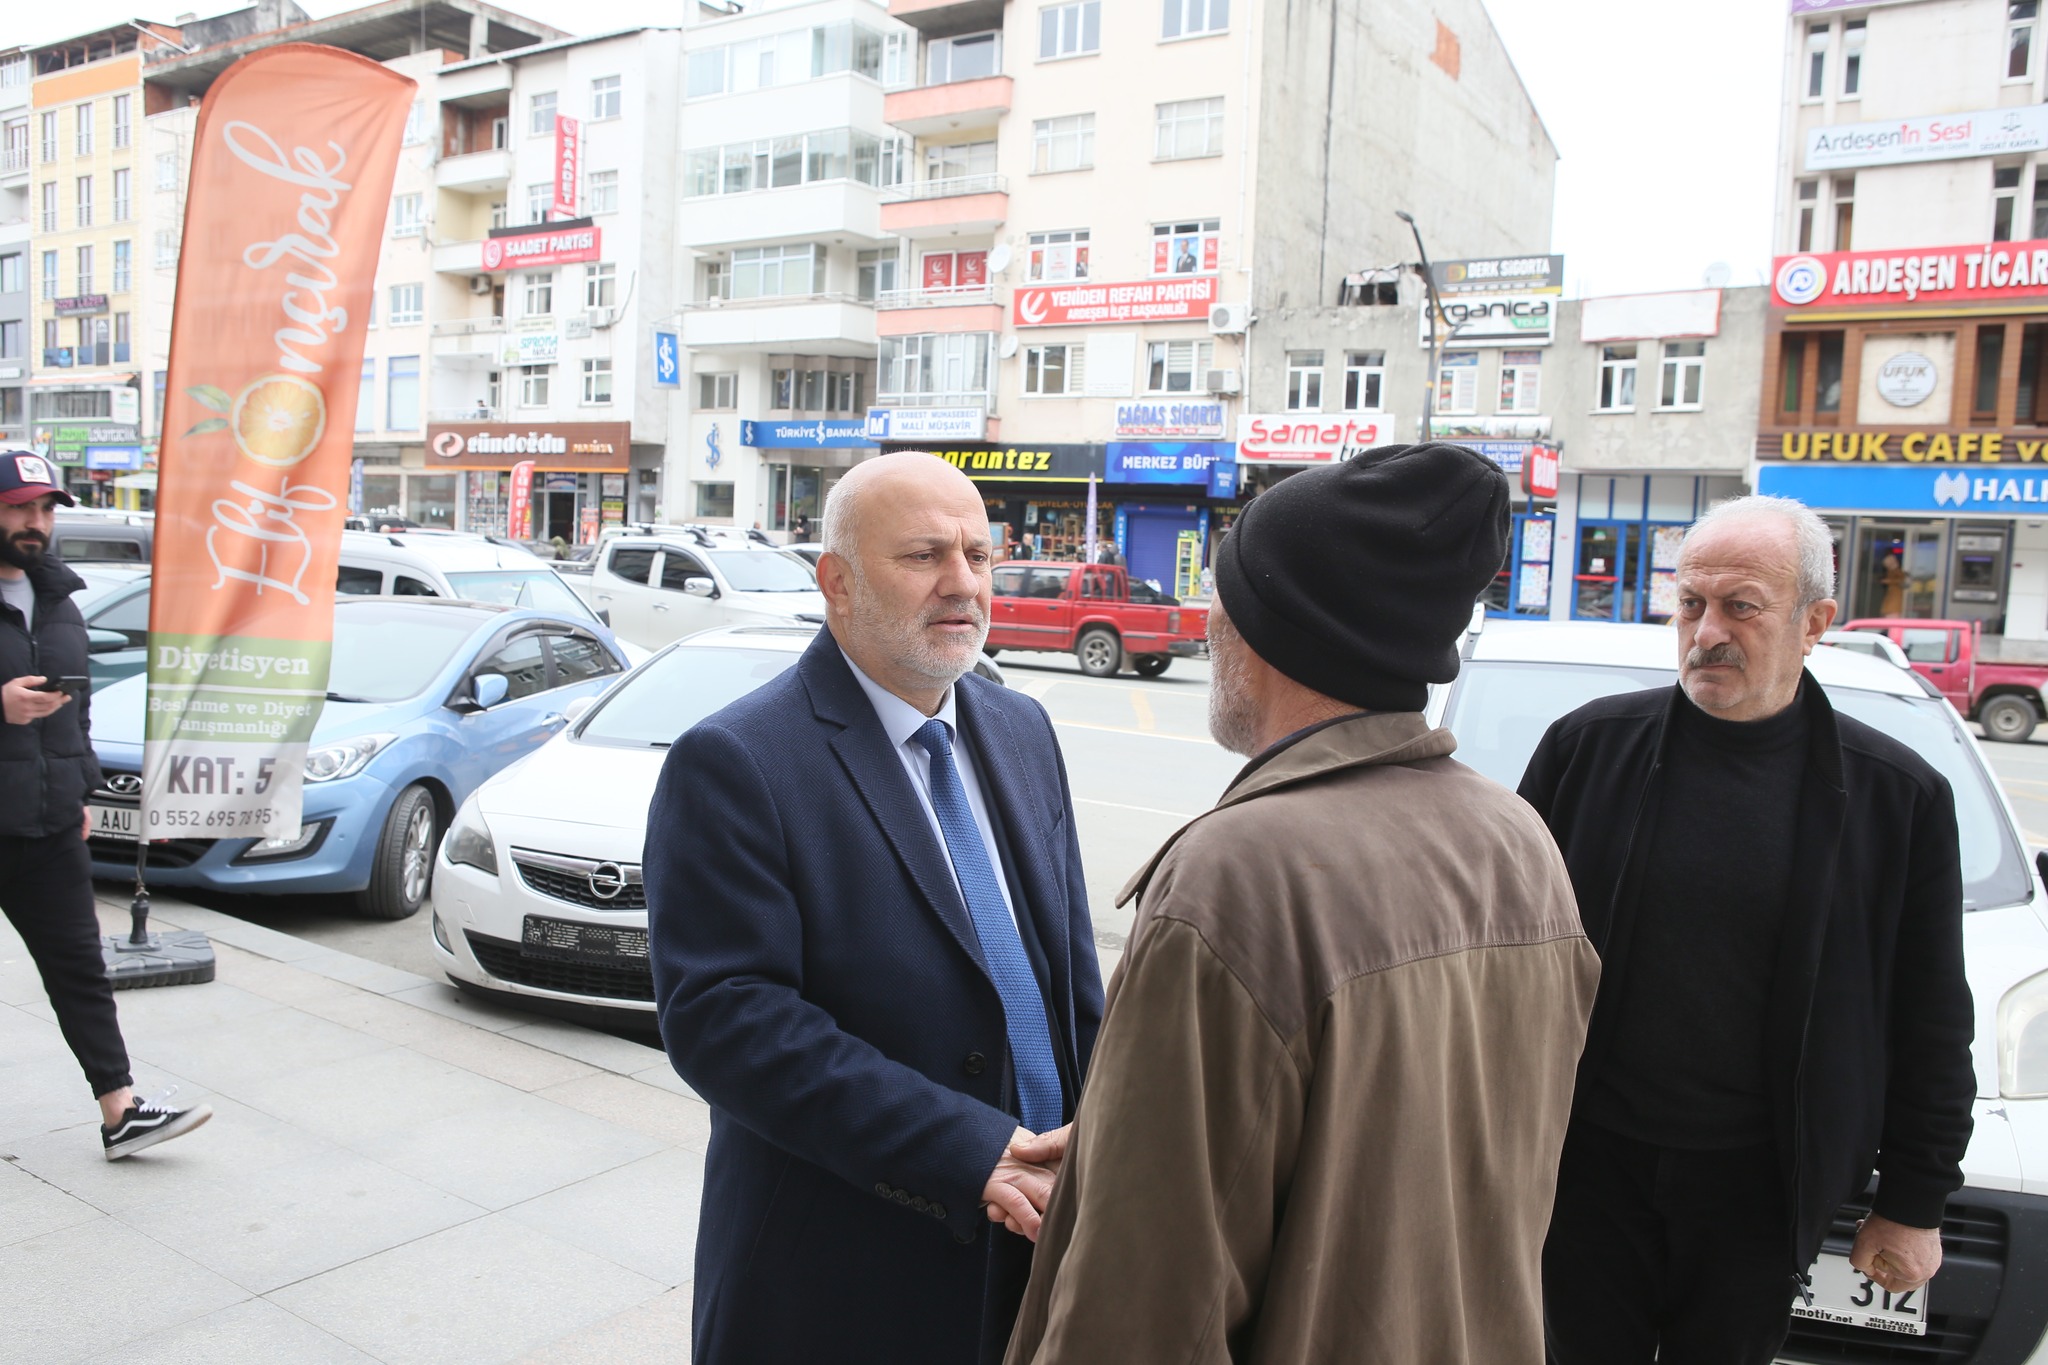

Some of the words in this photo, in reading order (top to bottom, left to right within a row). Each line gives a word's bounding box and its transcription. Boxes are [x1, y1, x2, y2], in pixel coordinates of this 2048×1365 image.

[505, 237, 548, 257] SAADET
[550, 232, 594, 252] PARTİSİ
[1832, 253, 1957, 301] ARDEŞEN
[1051, 286, 1107, 307] YENİDEN
[1109, 285, 1153, 304] REFAH
[1156, 279, 1211, 302] PARTİSİ
[1066, 305, 1109, 321] ARDEŞEN
[775, 425, 816, 438] TÜRKİYE
[826, 427, 867, 441] BANKAS
[901, 420, 924, 431] MALİ
[928, 419, 971, 431] MÜŞAVİR
[1251, 419, 1378, 444] Samata
[467, 432, 567, 455] gündoğdu
[1781, 432, 1890, 462] UFUK
[1901, 431, 2003, 463] CAFE
[929, 448, 1053, 471] arantez
[1122, 455, 1178, 470] MERKEZ
[1183, 453, 1220, 470] BÜF
[157, 645, 311, 681] Diyetisyen
[235, 703, 258, 714] ve
[263, 701, 312, 719] Diyet
[167, 755, 244, 795] KAT:
[255, 758, 276, 795] 5
[101, 809, 131, 831] AAU
[150, 810, 160, 826] 0
[166, 810, 200, 826] 552
[206, 811, 236, 827] 695
